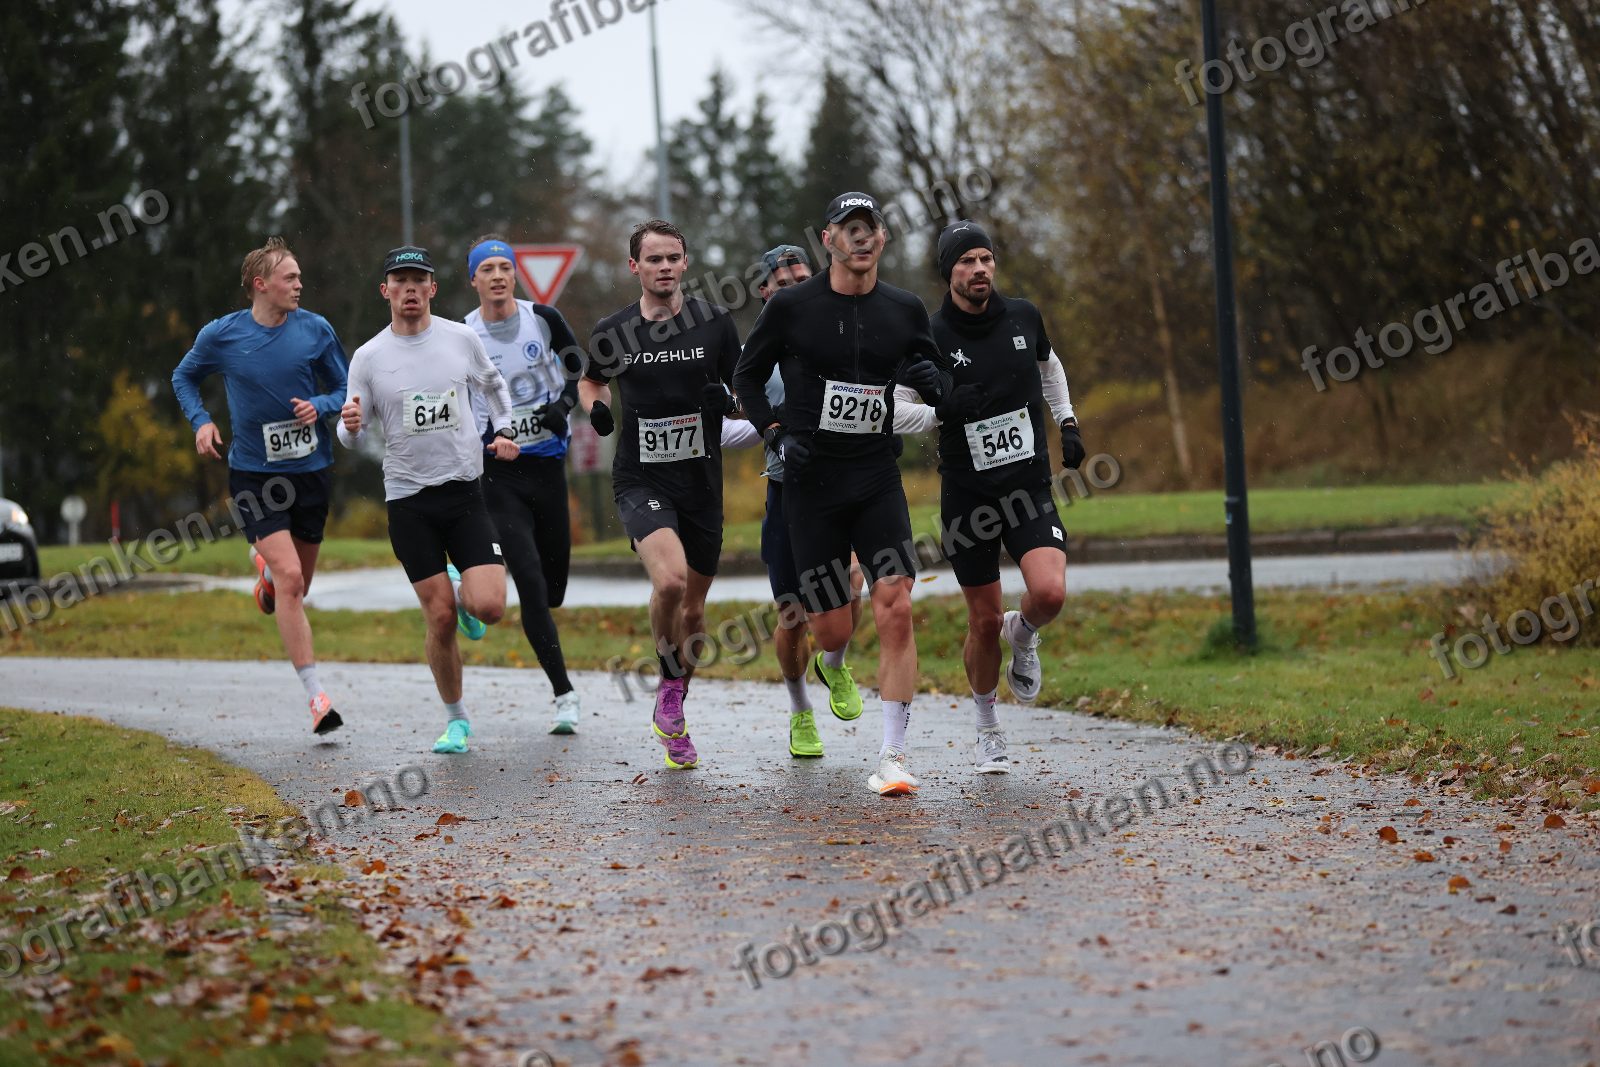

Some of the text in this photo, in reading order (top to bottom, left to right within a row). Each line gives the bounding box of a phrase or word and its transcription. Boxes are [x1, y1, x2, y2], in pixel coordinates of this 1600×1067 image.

[840, 198, 874, 209] HOKA
[395, 252, 424, 263] HOKA
[414, 403, 451, 427] 614
[828, 394, 882, 423] 9218
[269, 425, 312, 452] 9478
[644, 425, 698, 452] 9177
[982, 426, 1024, 458] 546
